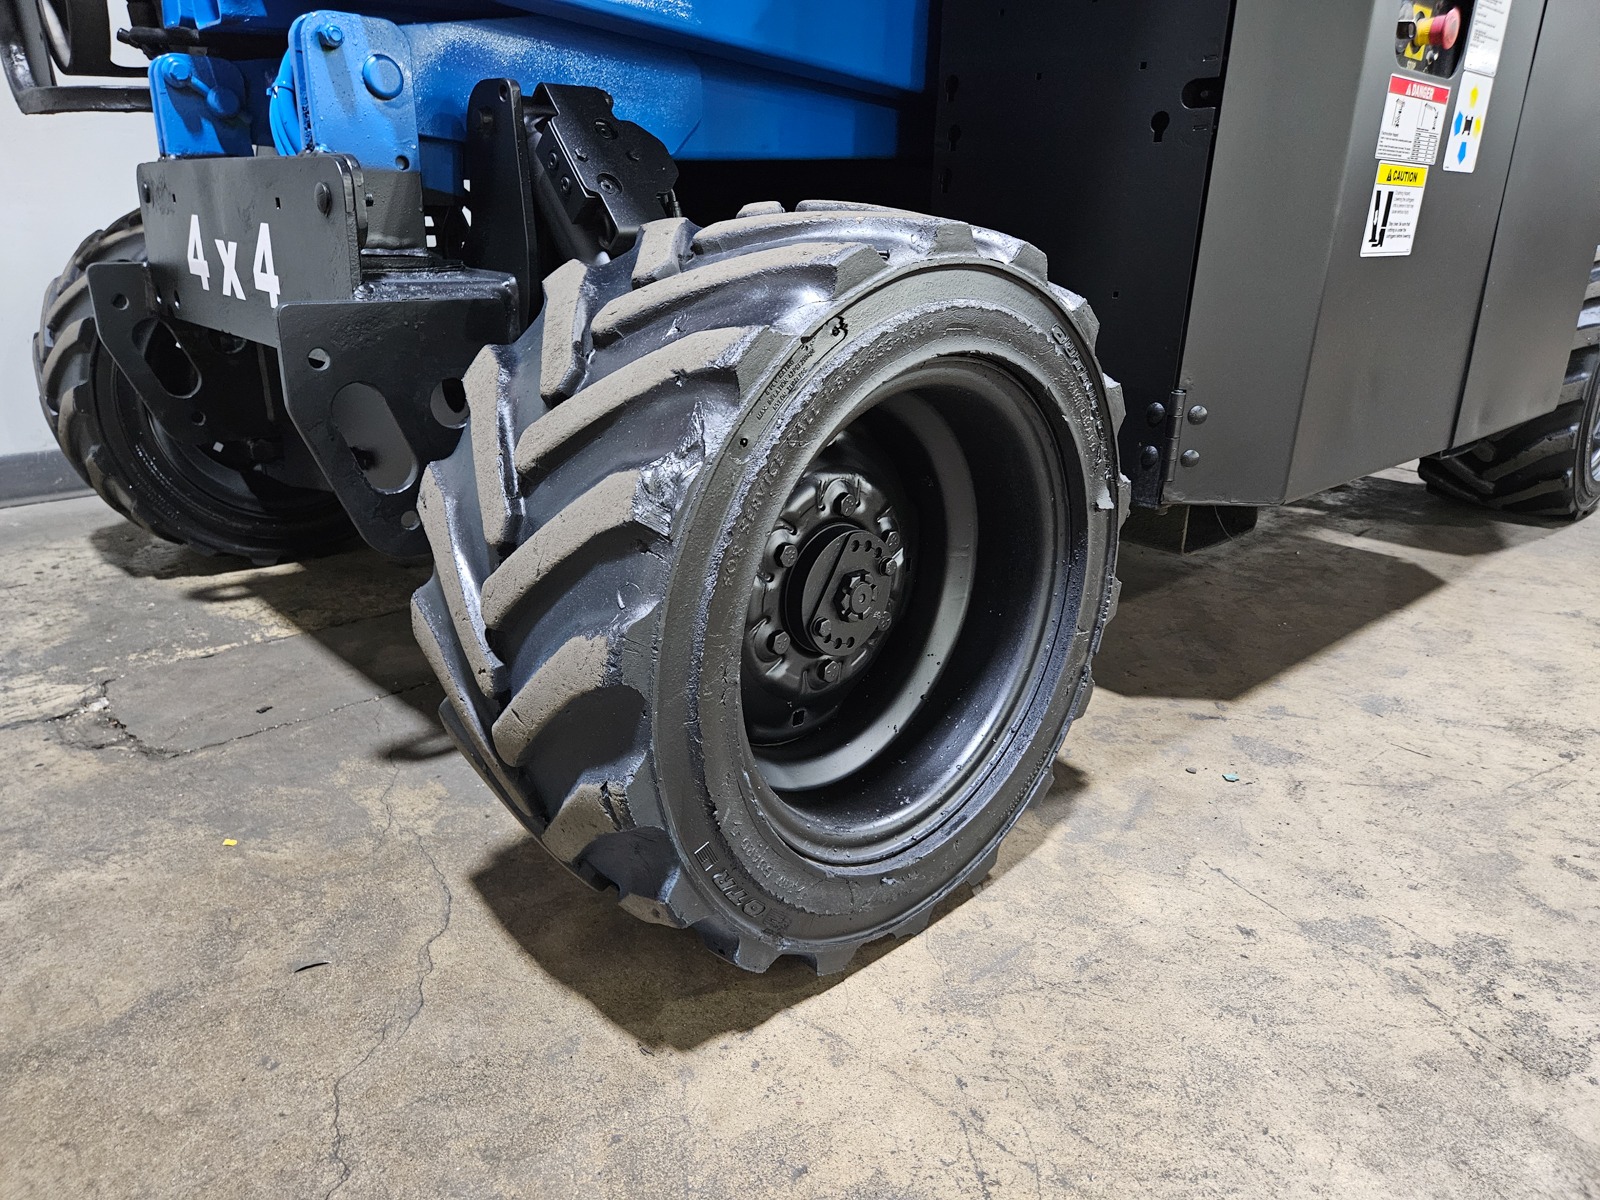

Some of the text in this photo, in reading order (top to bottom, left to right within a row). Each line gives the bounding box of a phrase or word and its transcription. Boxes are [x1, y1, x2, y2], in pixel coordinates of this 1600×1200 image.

[1411, 83, 1435, 100] DANGER
[1392, 170, 1418, 182] CAUTION
[739, 453, 785, 533] SERVICE
[712, 869, 766, 918] OTR
